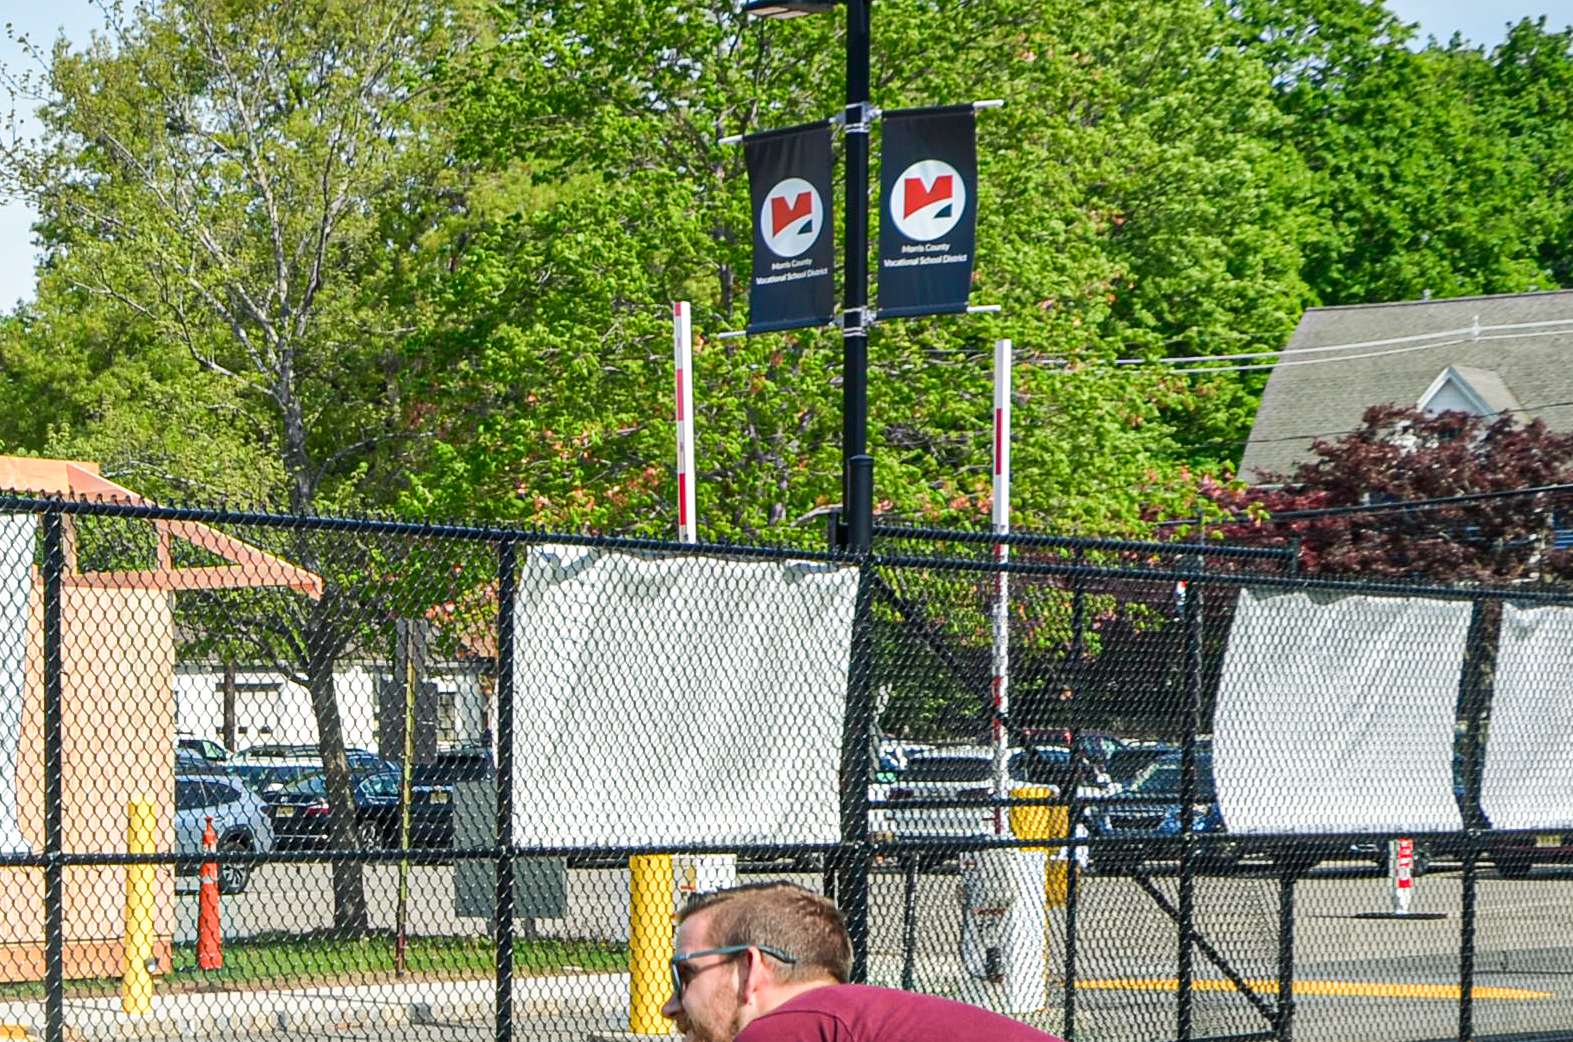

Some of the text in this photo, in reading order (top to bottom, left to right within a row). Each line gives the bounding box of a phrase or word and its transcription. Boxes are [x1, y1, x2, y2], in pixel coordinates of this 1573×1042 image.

[901, 243, 951, 253] Morris County
[791, 258, 813, 268] County
[883, 253, 968, 268] Vocational School District
[755, 267, 828, 285] Vocational School District
